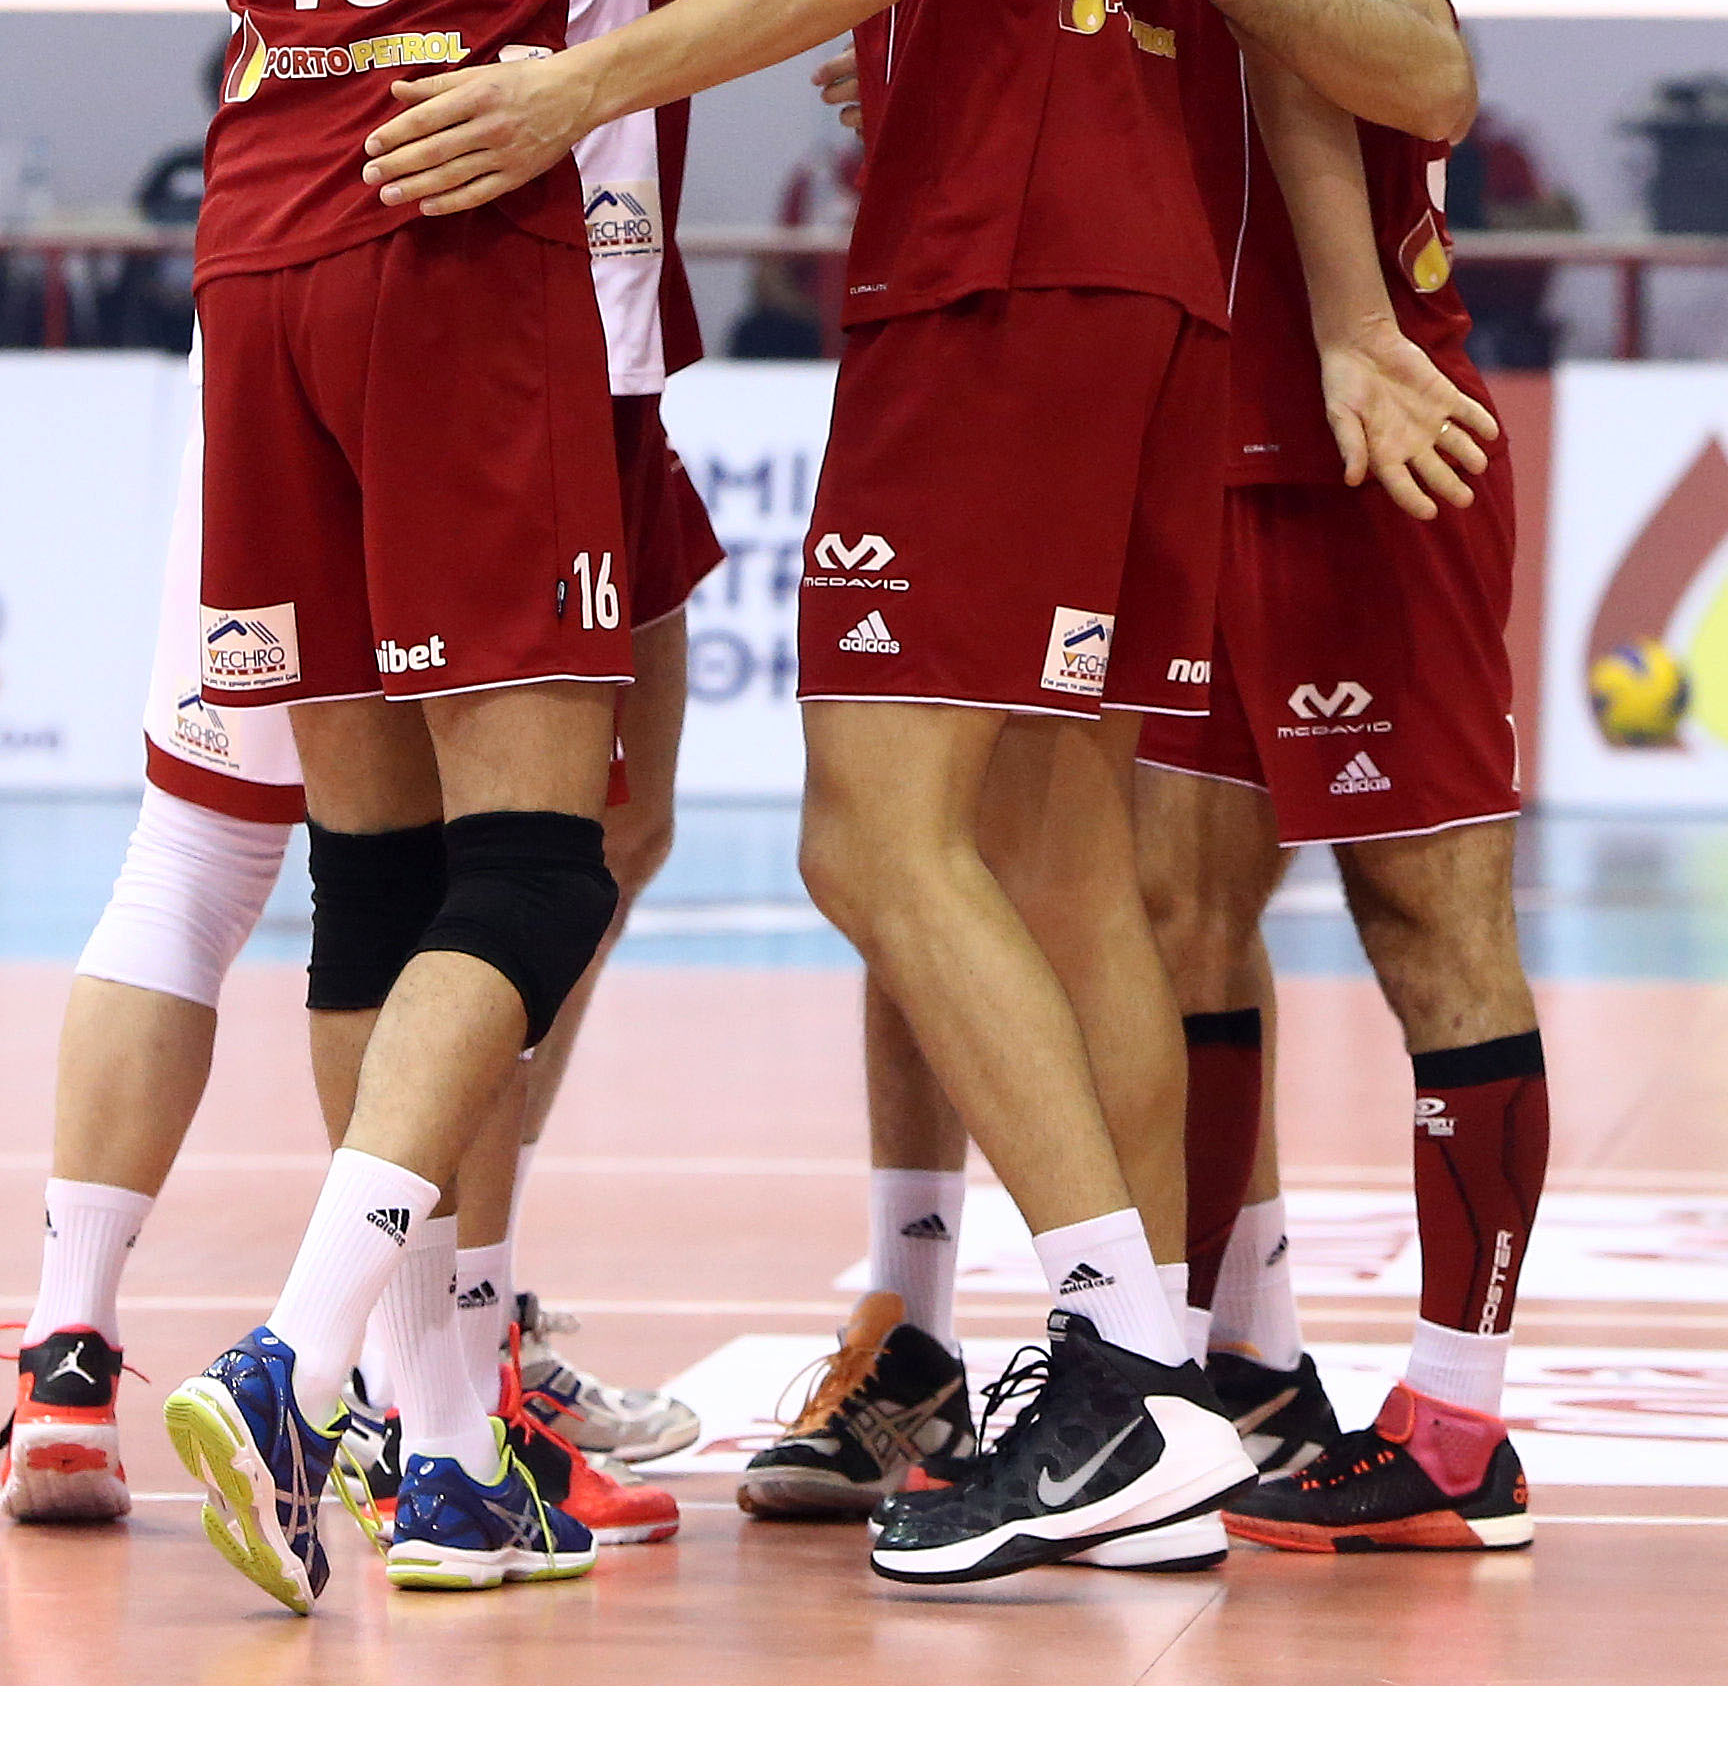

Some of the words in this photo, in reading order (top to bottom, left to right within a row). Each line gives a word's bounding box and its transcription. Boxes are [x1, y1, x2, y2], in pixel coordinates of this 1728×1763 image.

[263, 46, 351, 79] PORTO
[350, 31, 472, 73] PETROL
[573, 552, 620, 631] 16
[208, 646, 285, 669] VECHRO
[838, 638, 900, 654] adidas
[1329, 776, 1392, 795] adidas
[366, 1211, 407, 1248] adidas
[1059, 1276, 1115, 1296] adidas
